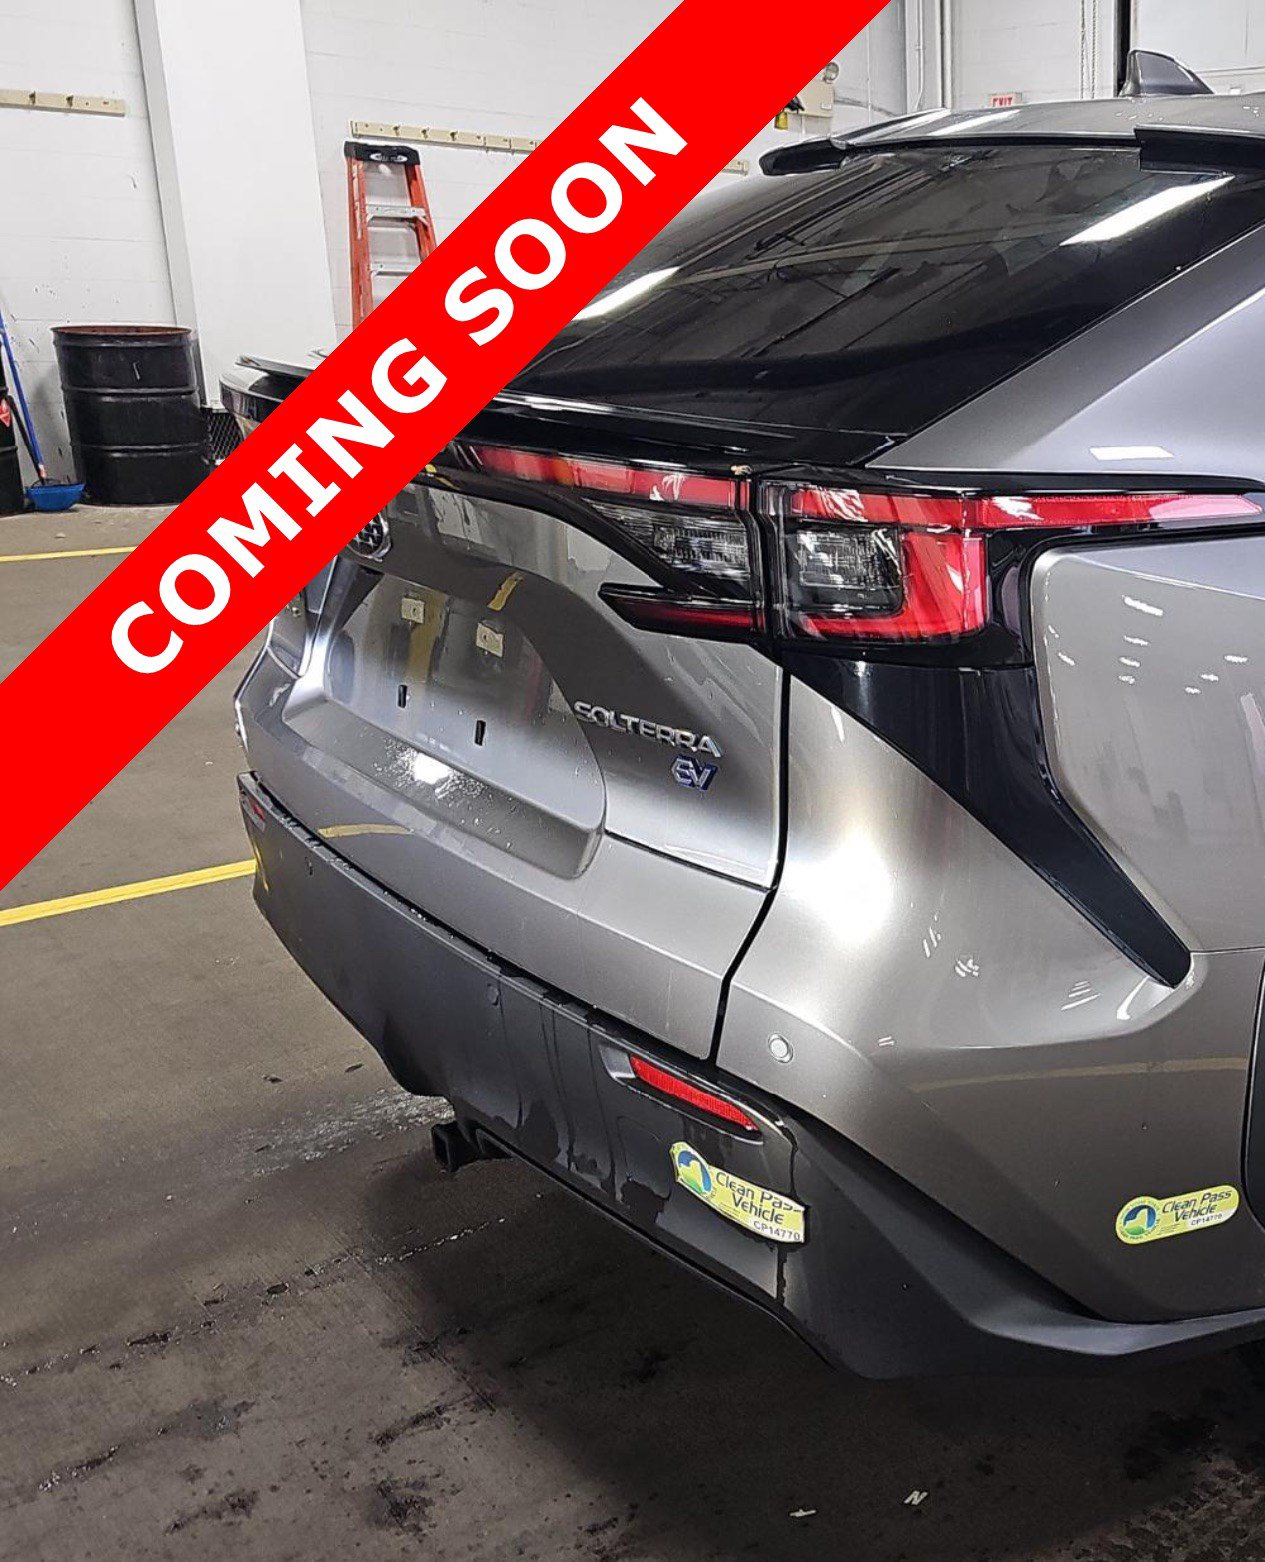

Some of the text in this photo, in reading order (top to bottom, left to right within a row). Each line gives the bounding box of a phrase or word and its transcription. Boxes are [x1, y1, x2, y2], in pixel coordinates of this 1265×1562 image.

[574, 701, 722, 758] SOLTERRA
[671, 754, 718, 791] EV
[715, 1171, 755, 1200] Clean
[760, 1191, 802, 1213] Pas
[732, 1192, 785, 1225] Vehicle
[1162, 1190, 1232, 1214] Clean Pass
[1174, 1203, 1218, 1222] Vehicle
[753, 1220, 801, 1241] CP14770
